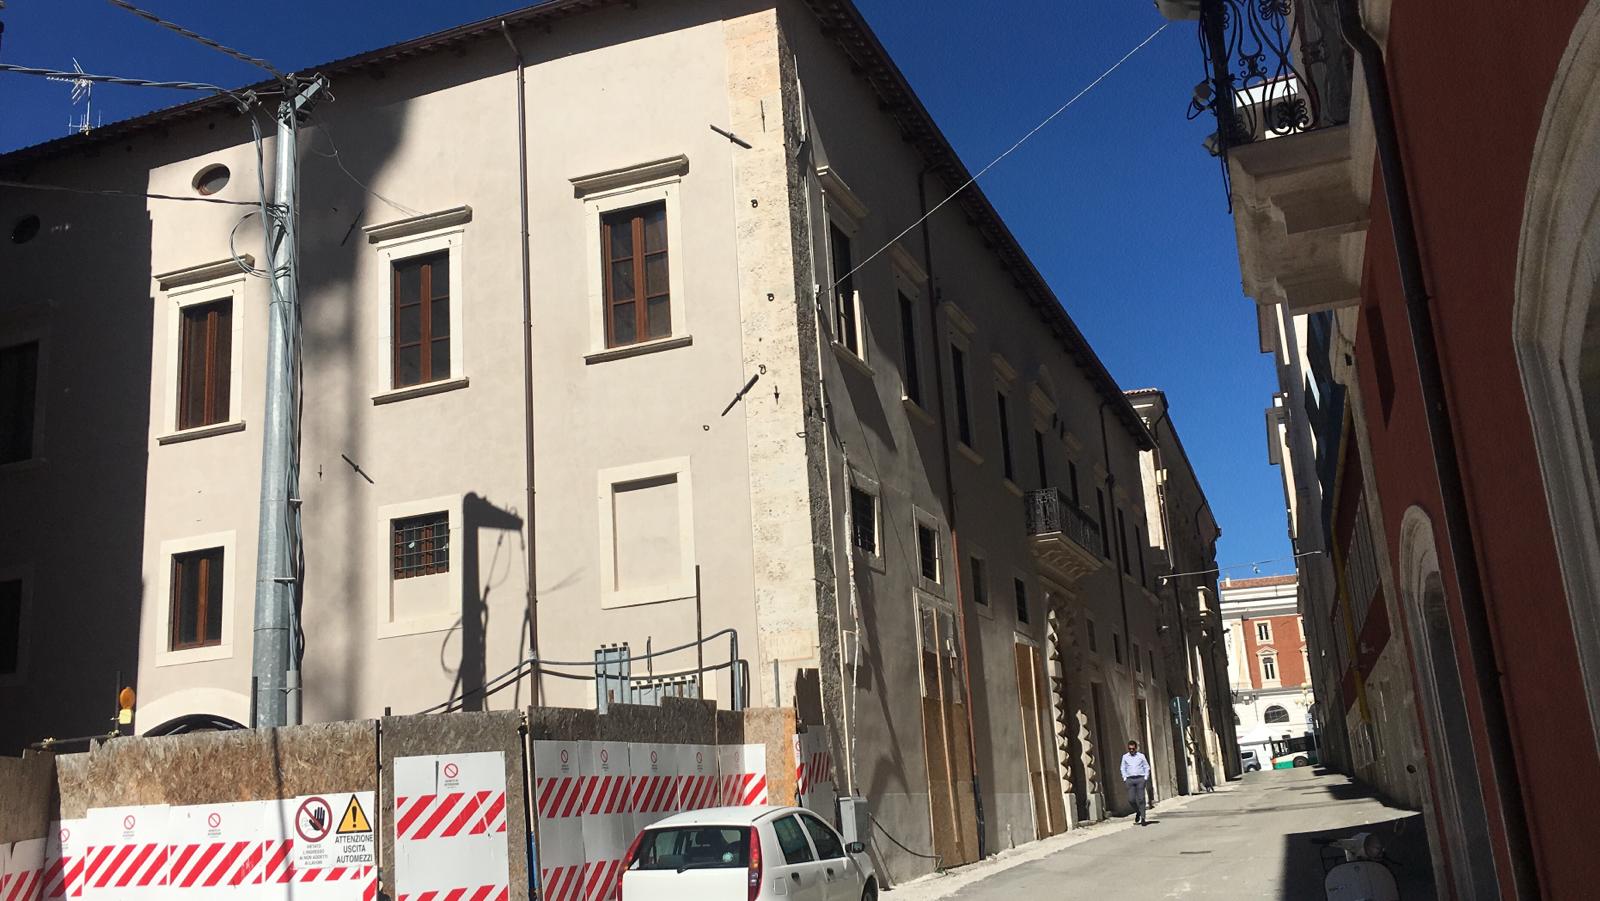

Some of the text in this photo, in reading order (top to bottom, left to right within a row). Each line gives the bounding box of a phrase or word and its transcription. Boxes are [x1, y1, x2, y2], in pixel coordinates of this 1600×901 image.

[334, 834, 373, 844] ATTENZIONE
[343, 844, 366, 853] USCITA
[336, 854, 373, 864] AUTOMEZZI
